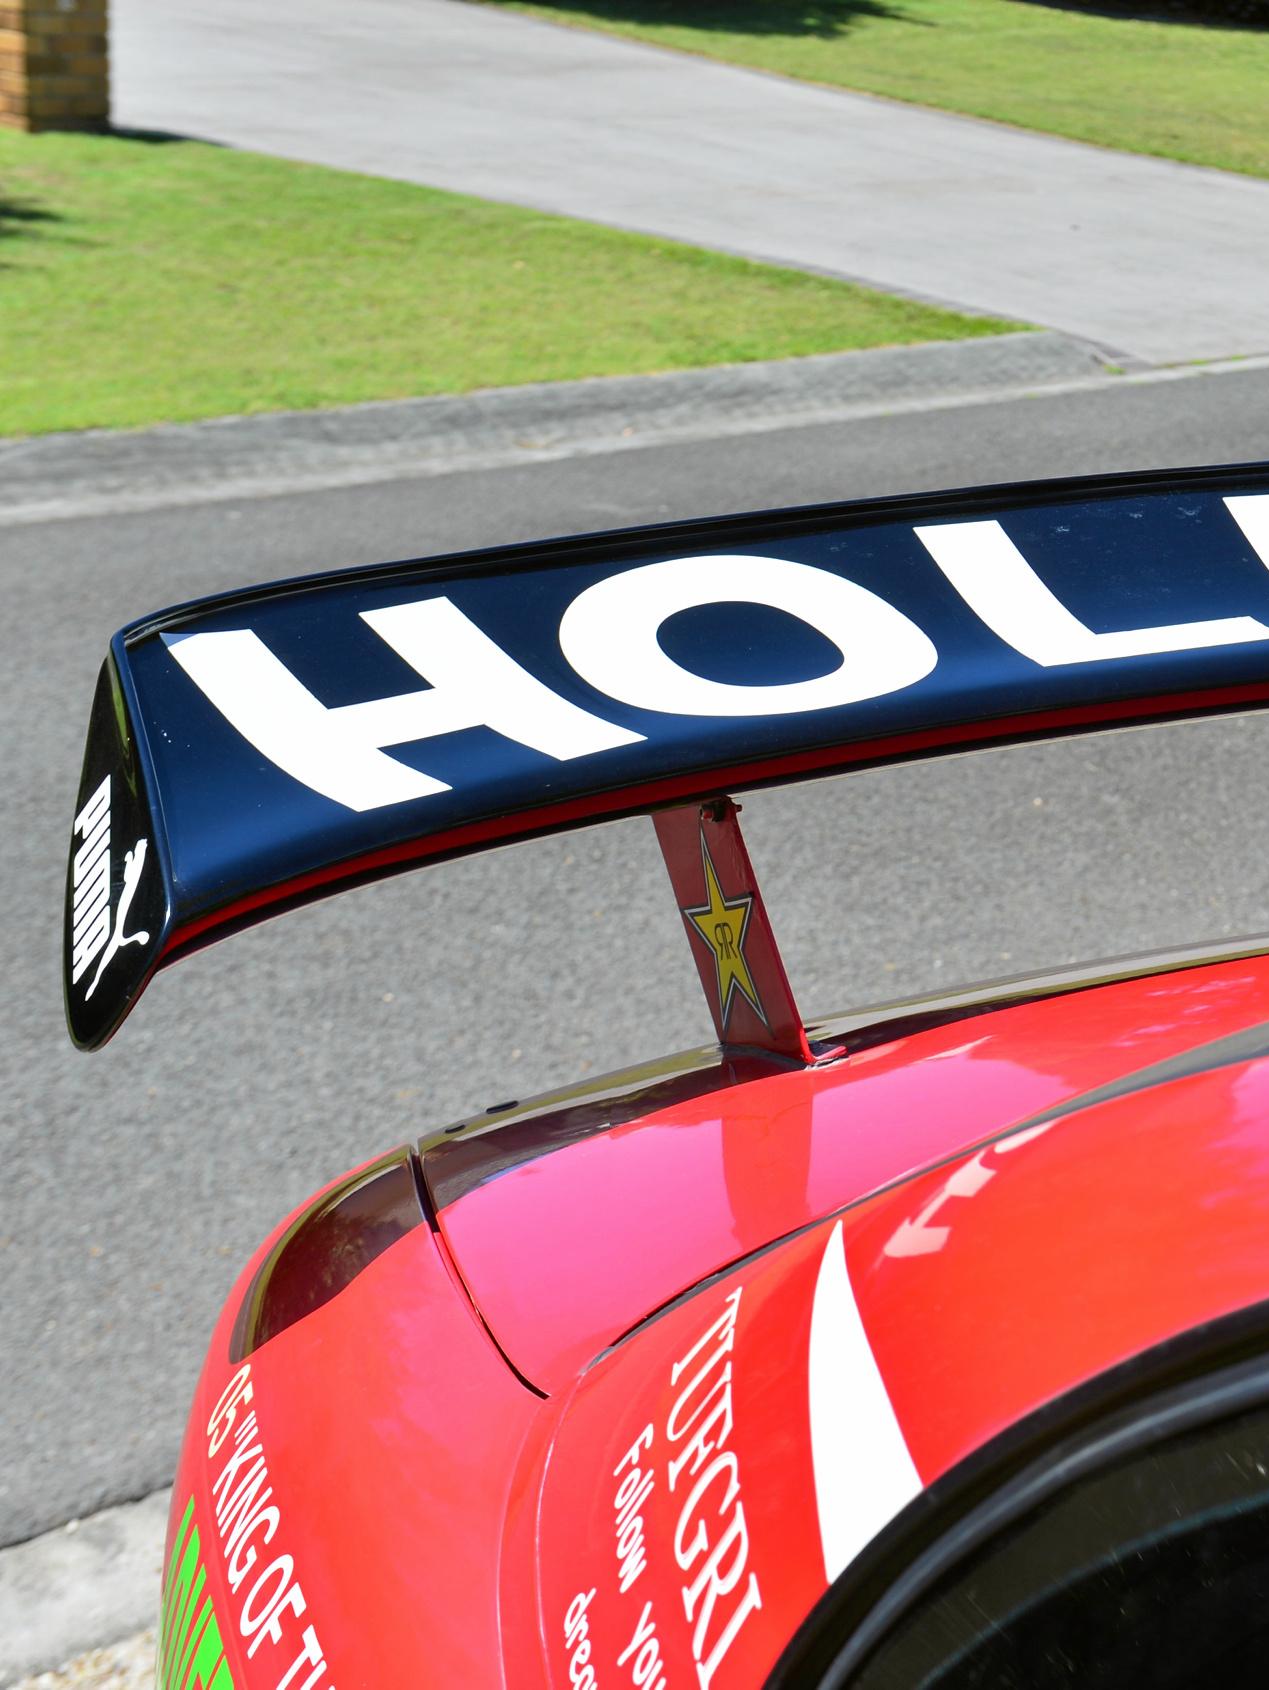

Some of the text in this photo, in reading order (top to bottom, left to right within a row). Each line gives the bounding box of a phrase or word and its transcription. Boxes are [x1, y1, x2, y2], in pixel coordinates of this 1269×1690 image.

[72, 773, 111, 985] PUMA
[613, 1422, 655, 1594] Follow
[239, 1553, 307, 1660] OF
